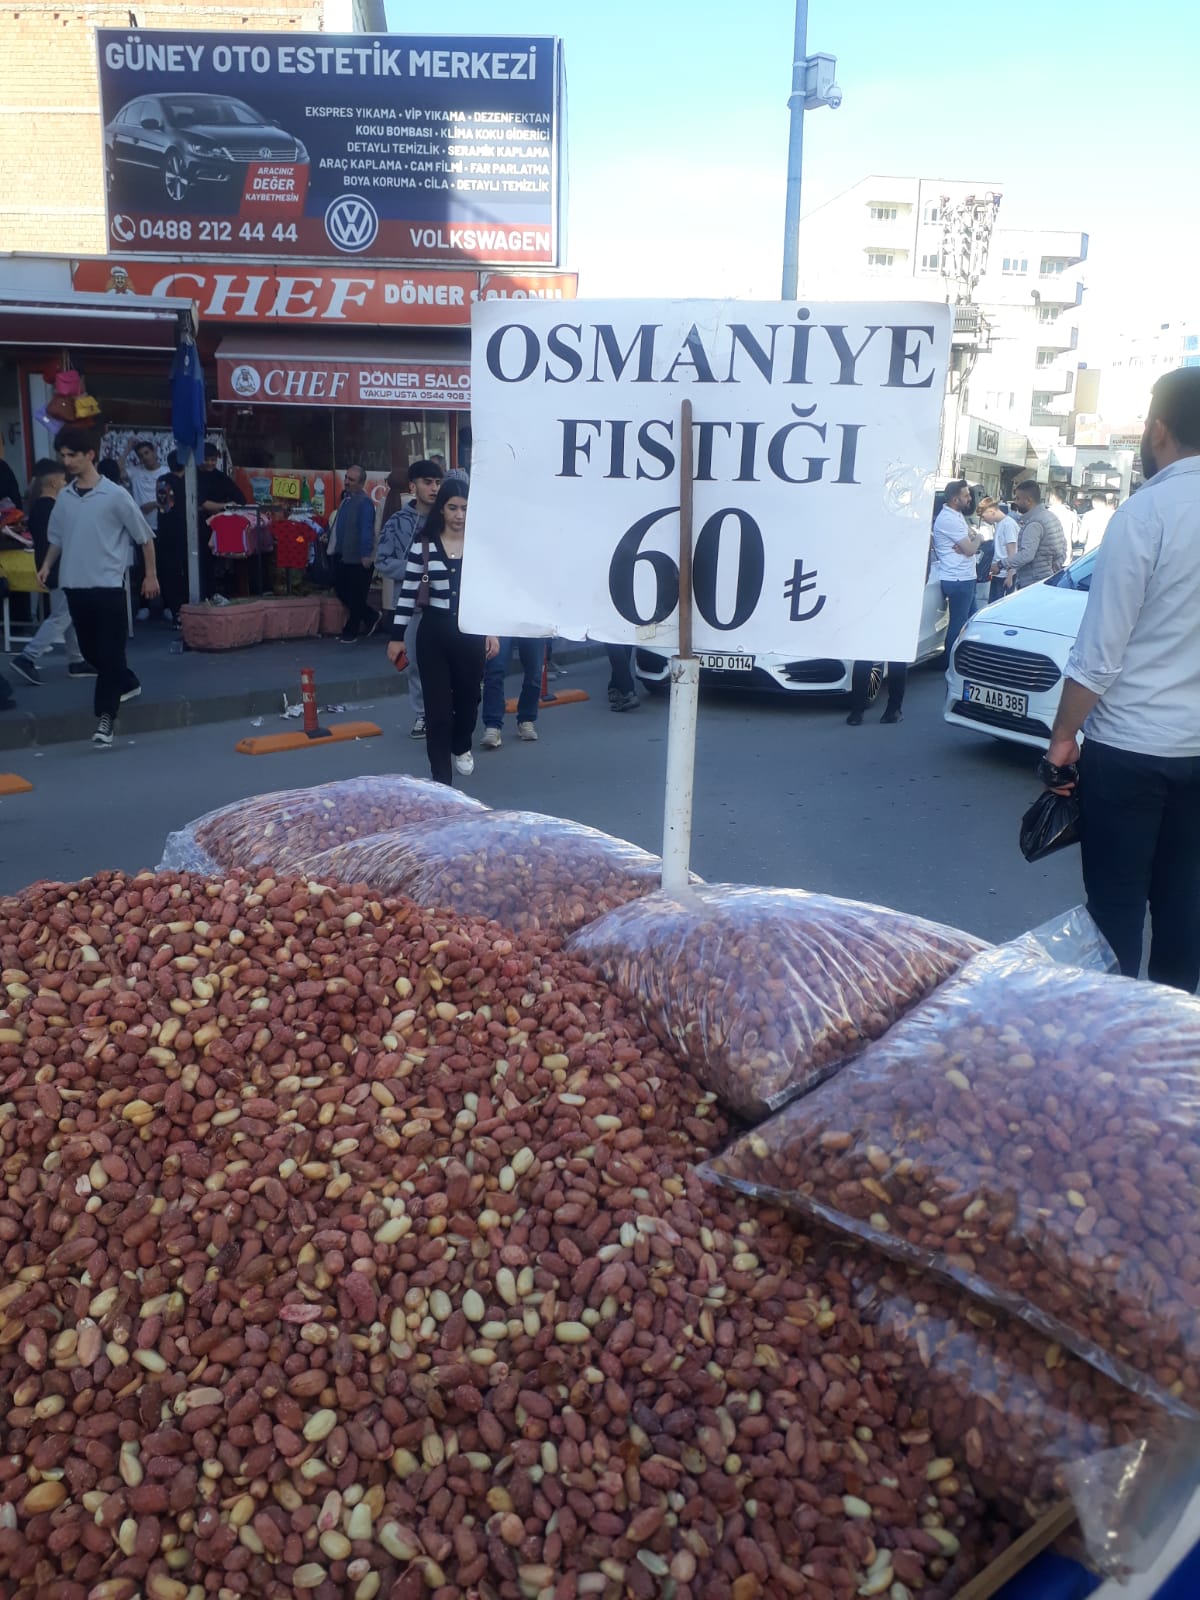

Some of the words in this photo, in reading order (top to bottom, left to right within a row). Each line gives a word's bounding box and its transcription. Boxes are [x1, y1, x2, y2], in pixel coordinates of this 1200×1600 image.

[105, 36, 204, 72] GÜNEY
[213, 45, 270, 73] OTO
[278, 41, 401, 76] ESTETİK
[409, 45, 536, 80] MERKEZİ
[305, 106, 353, 118] EKSPRES
[356, 107, 397, 119] YIKAMA
[404, 107, 422, 120] VİP
[424, 110, 466, 122] YIKAMA
[473, 111, 550, 124] DEZENFEKTAN
[355, 125, 384, 136] KOKU
[386, 126, 432, 138] BOMBASI
[440, 126, 474, 140] KLİMA
[475, 128, 505, 140] KOKU
[505, 126, 550, 141] GİDERİCİ
[347, 142, 390, 153] DETAYLI
[392, 141, 440, 155] TEMİZLİK
[447, 144, 495, 157] SERAMİK
[496, 145, 550, 158] KAPLAMA
[257, 167, 294, 175] ARACINIZ
[319, 158, 348, 171] ARAÇ
[350, 158, 402, 170] KAPLAMA
[410, 161, 433, 172] CAM
[435, 160, 463, 173] FİLMİ
[470, 162, 491, 174] FAR
[492, 163, 550, 175] PARLATMA
[253, 176, 295, 191] DEĞER
[343, 176, 370, 187] BOYA
[372, 176, 416, 188] KORUMA
[424, 176, 449, 189] CİLA
[456, 178, 500, 191] DETAYLI
[501, 178, 549, 192] TEMİZLİK
[245, 192, 299, 202] KAYBETMESİN
[139, 219, 191, 240] 0488
[198, 221, 232, 241] 212
[238, 222, 265, 241] 44
[271, 222, 298, 242] 44
[409, 228, 550, 251] VOLKSWAGEN
[151, 273, 375, 318] CHEF
[384, 280, 464, 306] DÖNER
[485, 307, 936, 389] OSMANİYE
[263, 369, 350, 397] CHEF
[359, 370, 419, 387] DÖNER
[424, 373, 471, 388] SALO
[363, 389, 392, 398] YAKUP
[394, 390, 417, 399] USTA
[419, 391, 444, 399] 0544
[554, 402, 867, 484] FISTIĞI
[608, 506, 765, 631] 60
[708, 656, 724, 668] DD
[727, 657, 751, 669] 0114
[969, 686, 981, 701] 72
[985, 689, 1003, 706] AAB
[1005, 695, 1024, 712] 385
